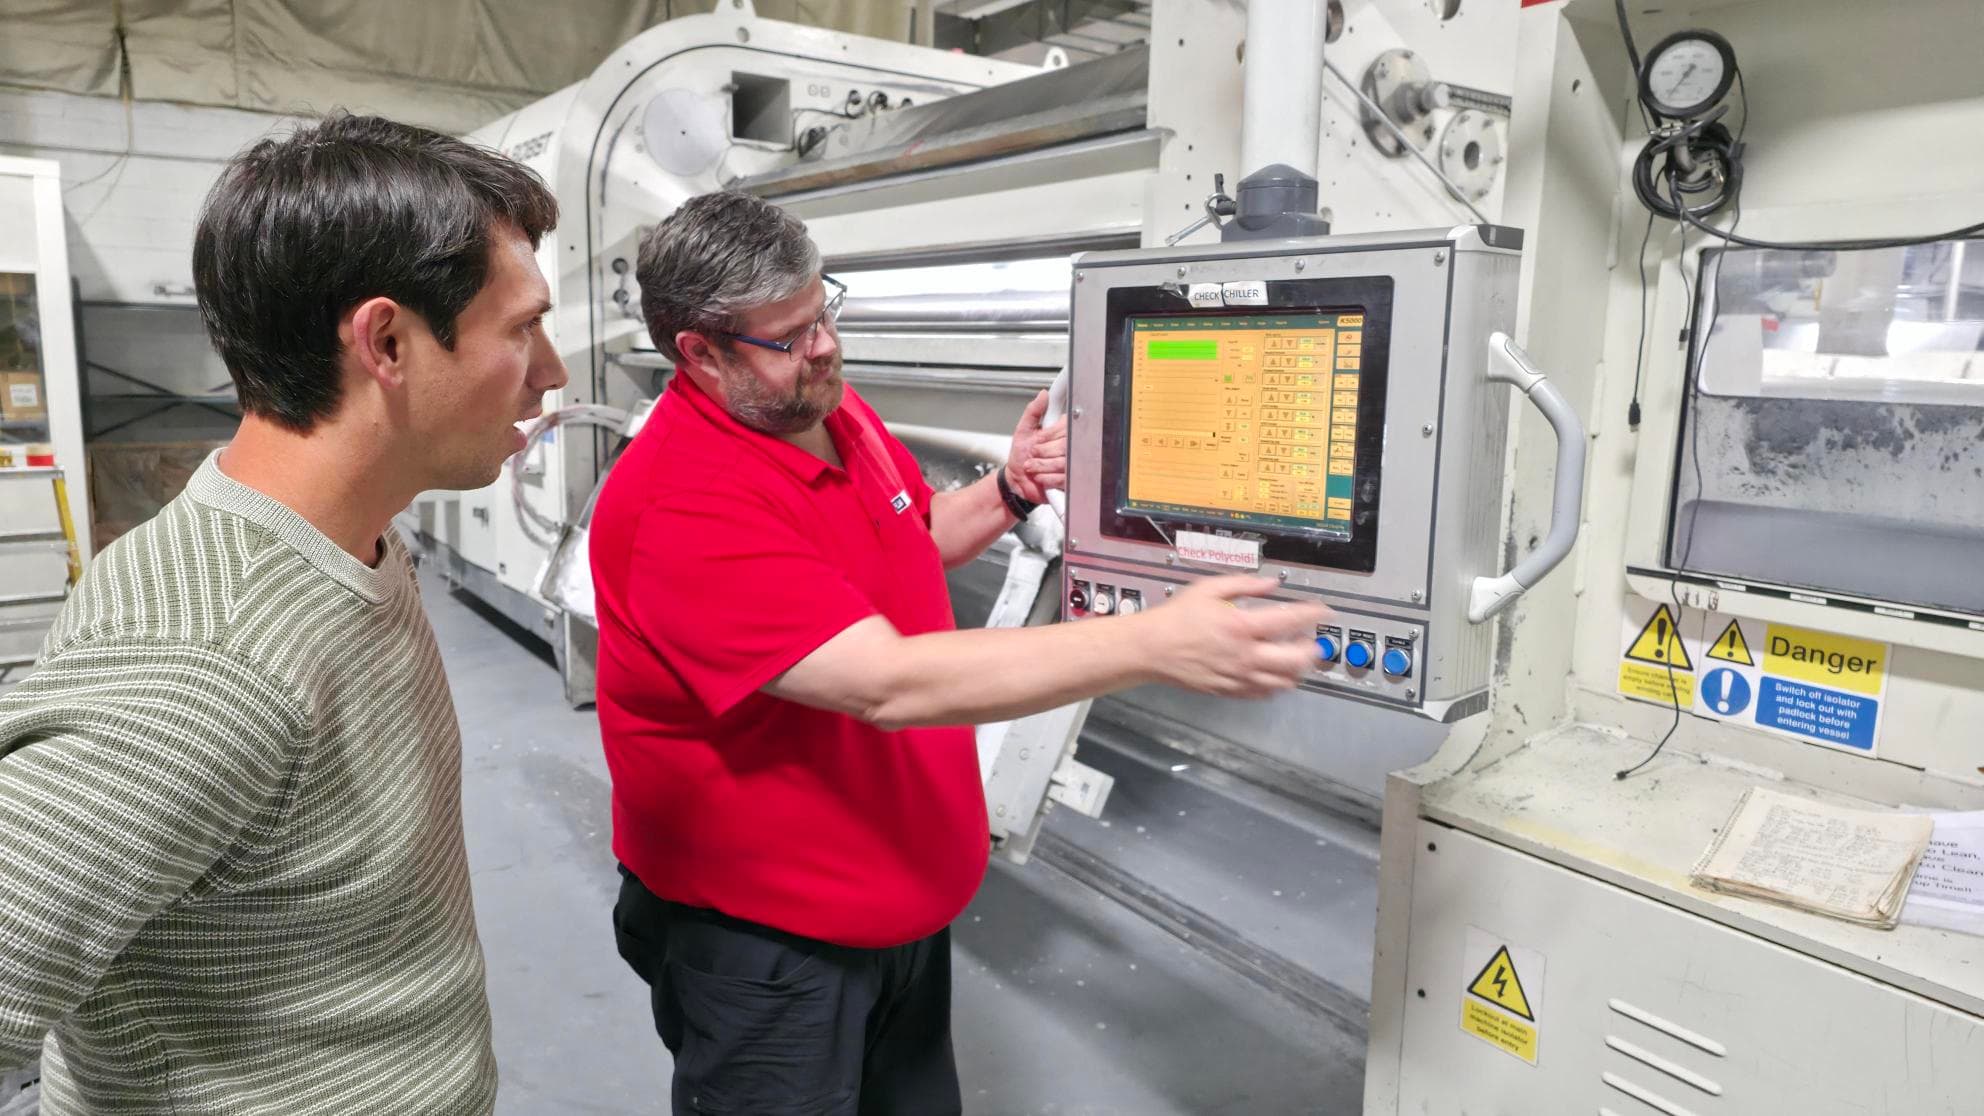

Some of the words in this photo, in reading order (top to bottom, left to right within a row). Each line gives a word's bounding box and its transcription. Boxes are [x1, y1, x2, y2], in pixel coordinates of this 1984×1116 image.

[1194, 291, 1219, 301] CHECK
[1222, 288, 1260, 299] CHILLER
[1178, 546, 1206, 558] Check
[1770, 635, 1877, 674] Danger
[1775, 682, 1806, 696] Switch
[1808, 691, 1822, 700] off
[1823, 694, 1861, 709] isolator
[1775, 695, 1794, 704] and
[1796, 697, 1816, 709] lock
[1818, 704, 1834, 713] out
[1836, 708, 1857, 719] with
[1777, 716, 1816, 732] entering
[1818, 726, 1850, 739] vessel
[1778, 706, 1816, 720] padlock
[1818, 714, 1851, 729] before
[1471, 1004, 1500, 1022] Lockout
[1469, 1014, 1499, 1031] machine
[1501, 1029, 1528, 1044] isolator
[1476, 1026, 1499, 1040] before
[1501, 1038, 1519, 1051] entry
